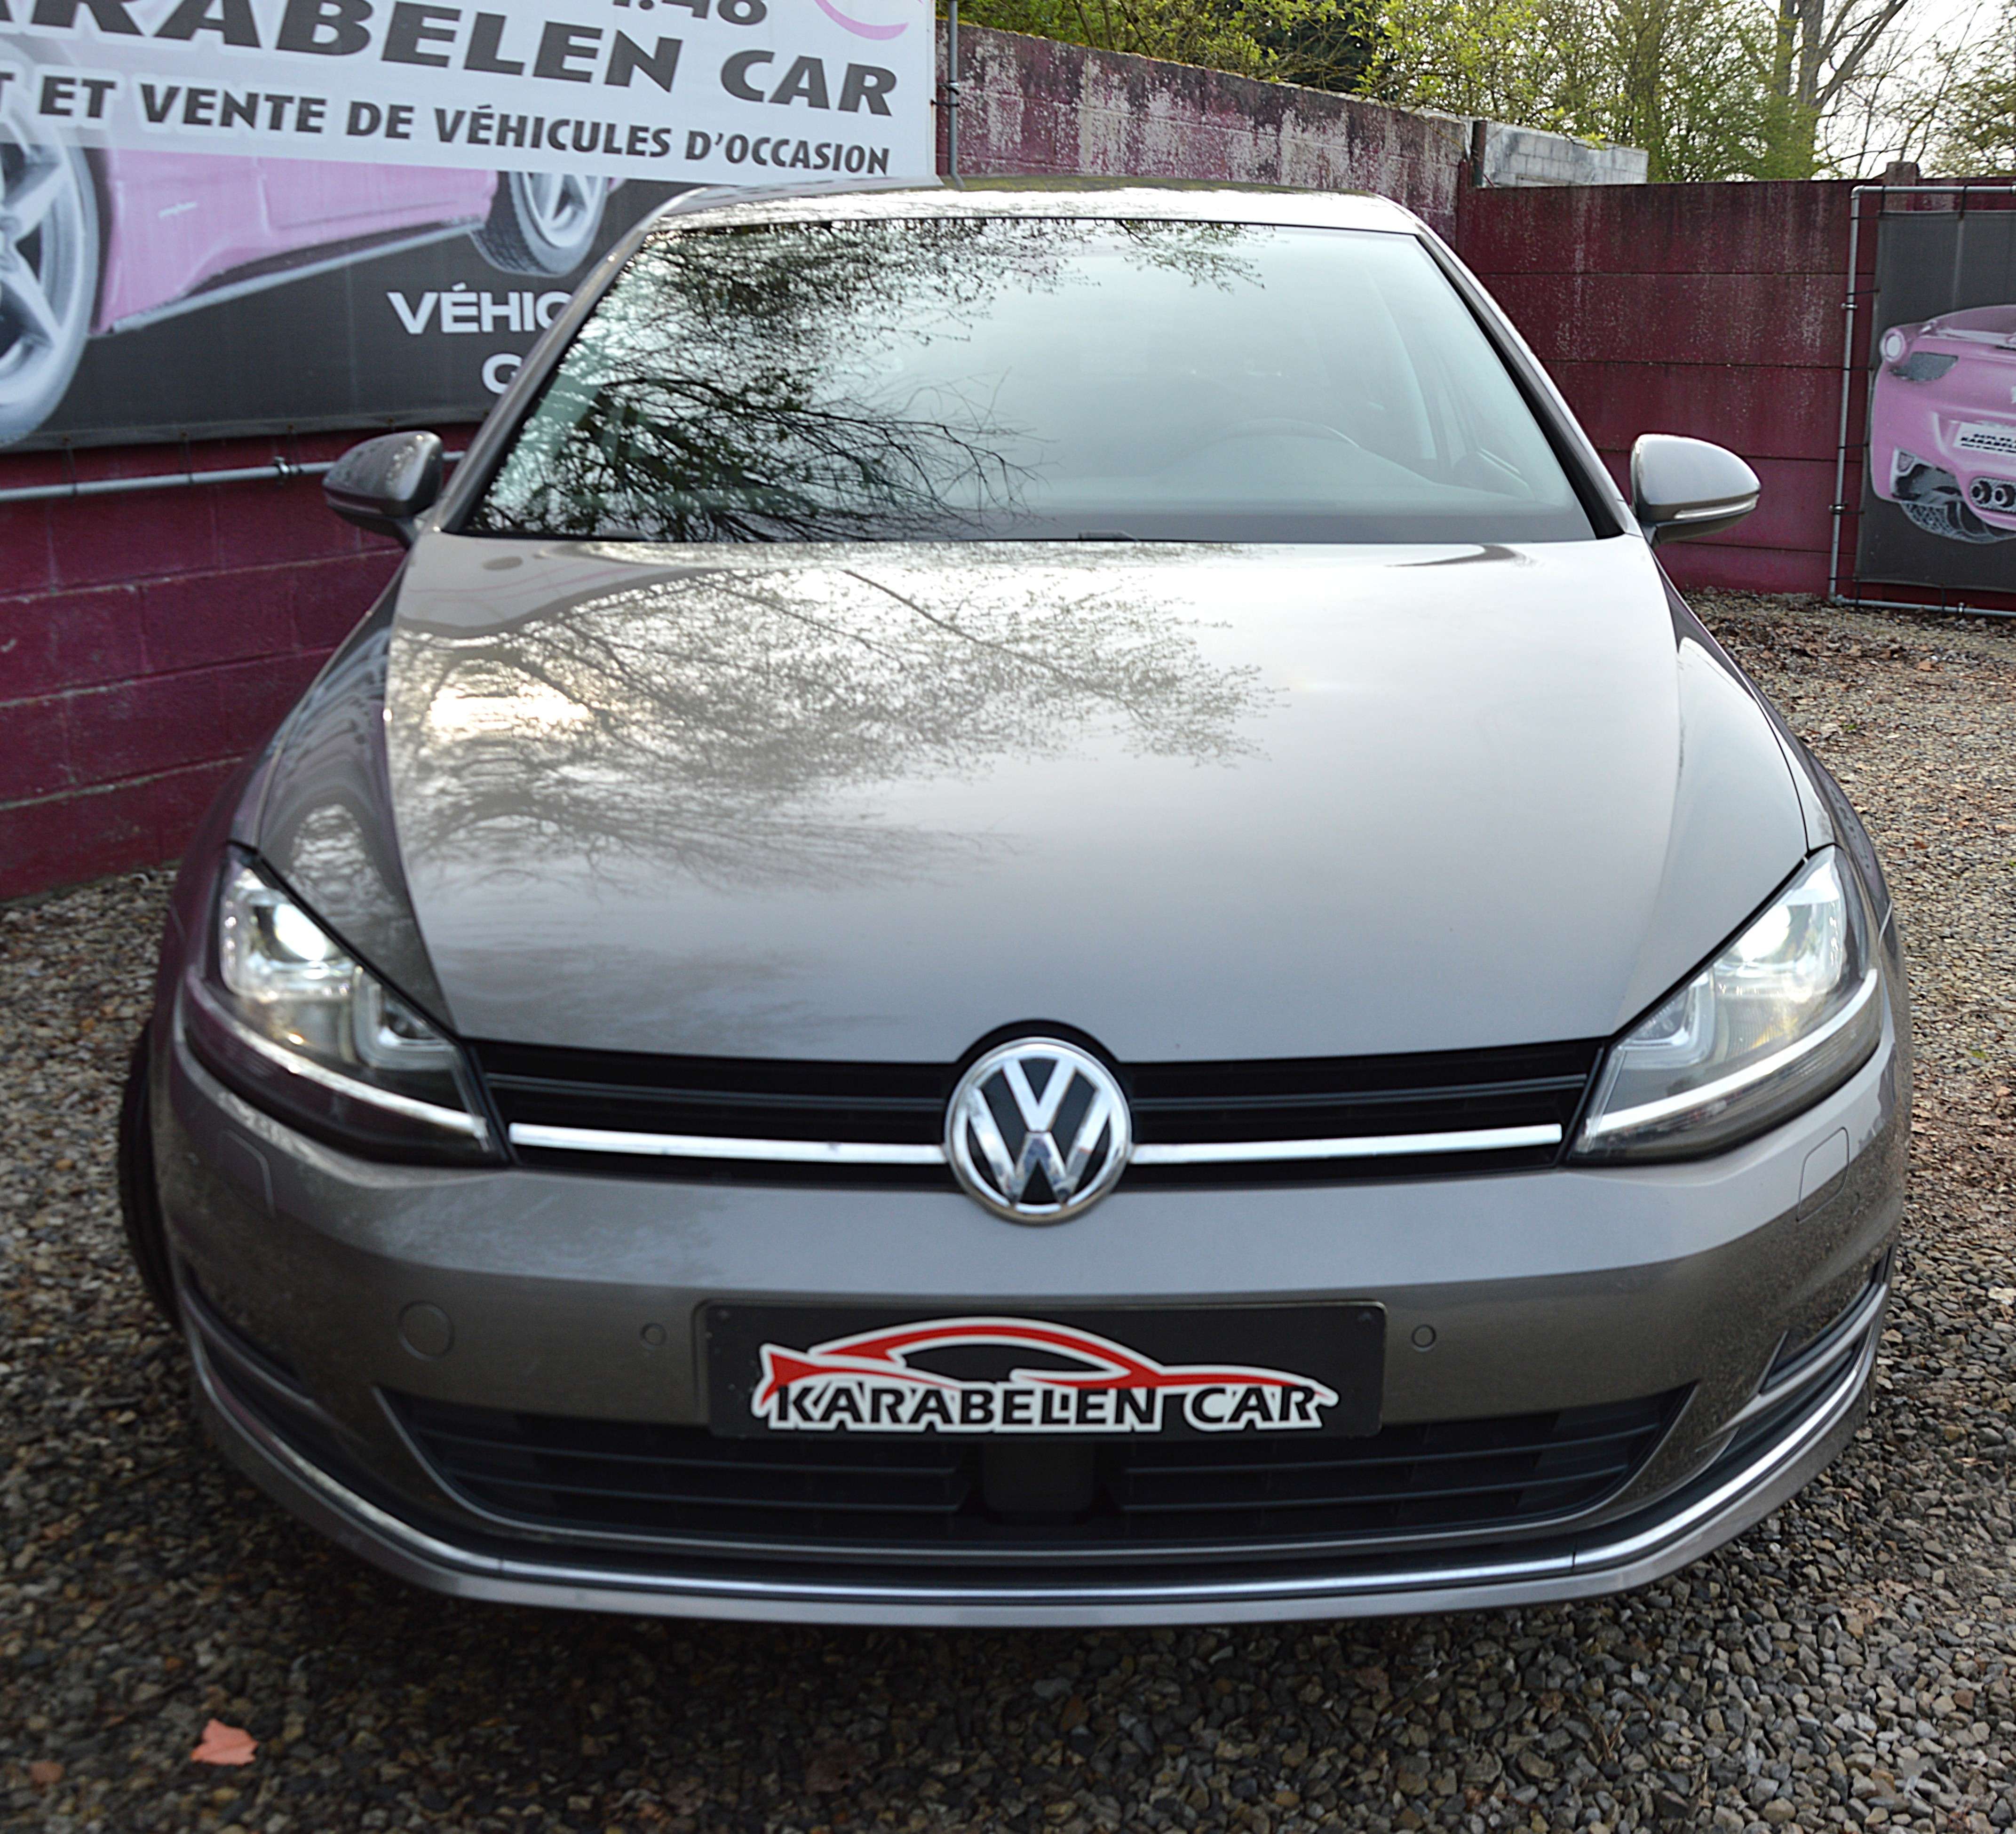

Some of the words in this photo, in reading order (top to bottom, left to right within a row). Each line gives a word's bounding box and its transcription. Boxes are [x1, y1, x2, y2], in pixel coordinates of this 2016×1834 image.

[0, 0, 683, 93] ABELEN
[720, 49, 897, 116] CAR
[40, 75, 117, 119] ET
[141, 83, 327, 134] VENTE
[346, 100, 414, 140] DE
[434, 104, 672, 159] VÉHICULES
[685, 129, 889, 176] D'OCCASION
[957, 1050, 1119, 1211] VW
[775, 1382, 1158, 1425] KARABELEN
[1191, 1385, 1317, 1423] CAR
